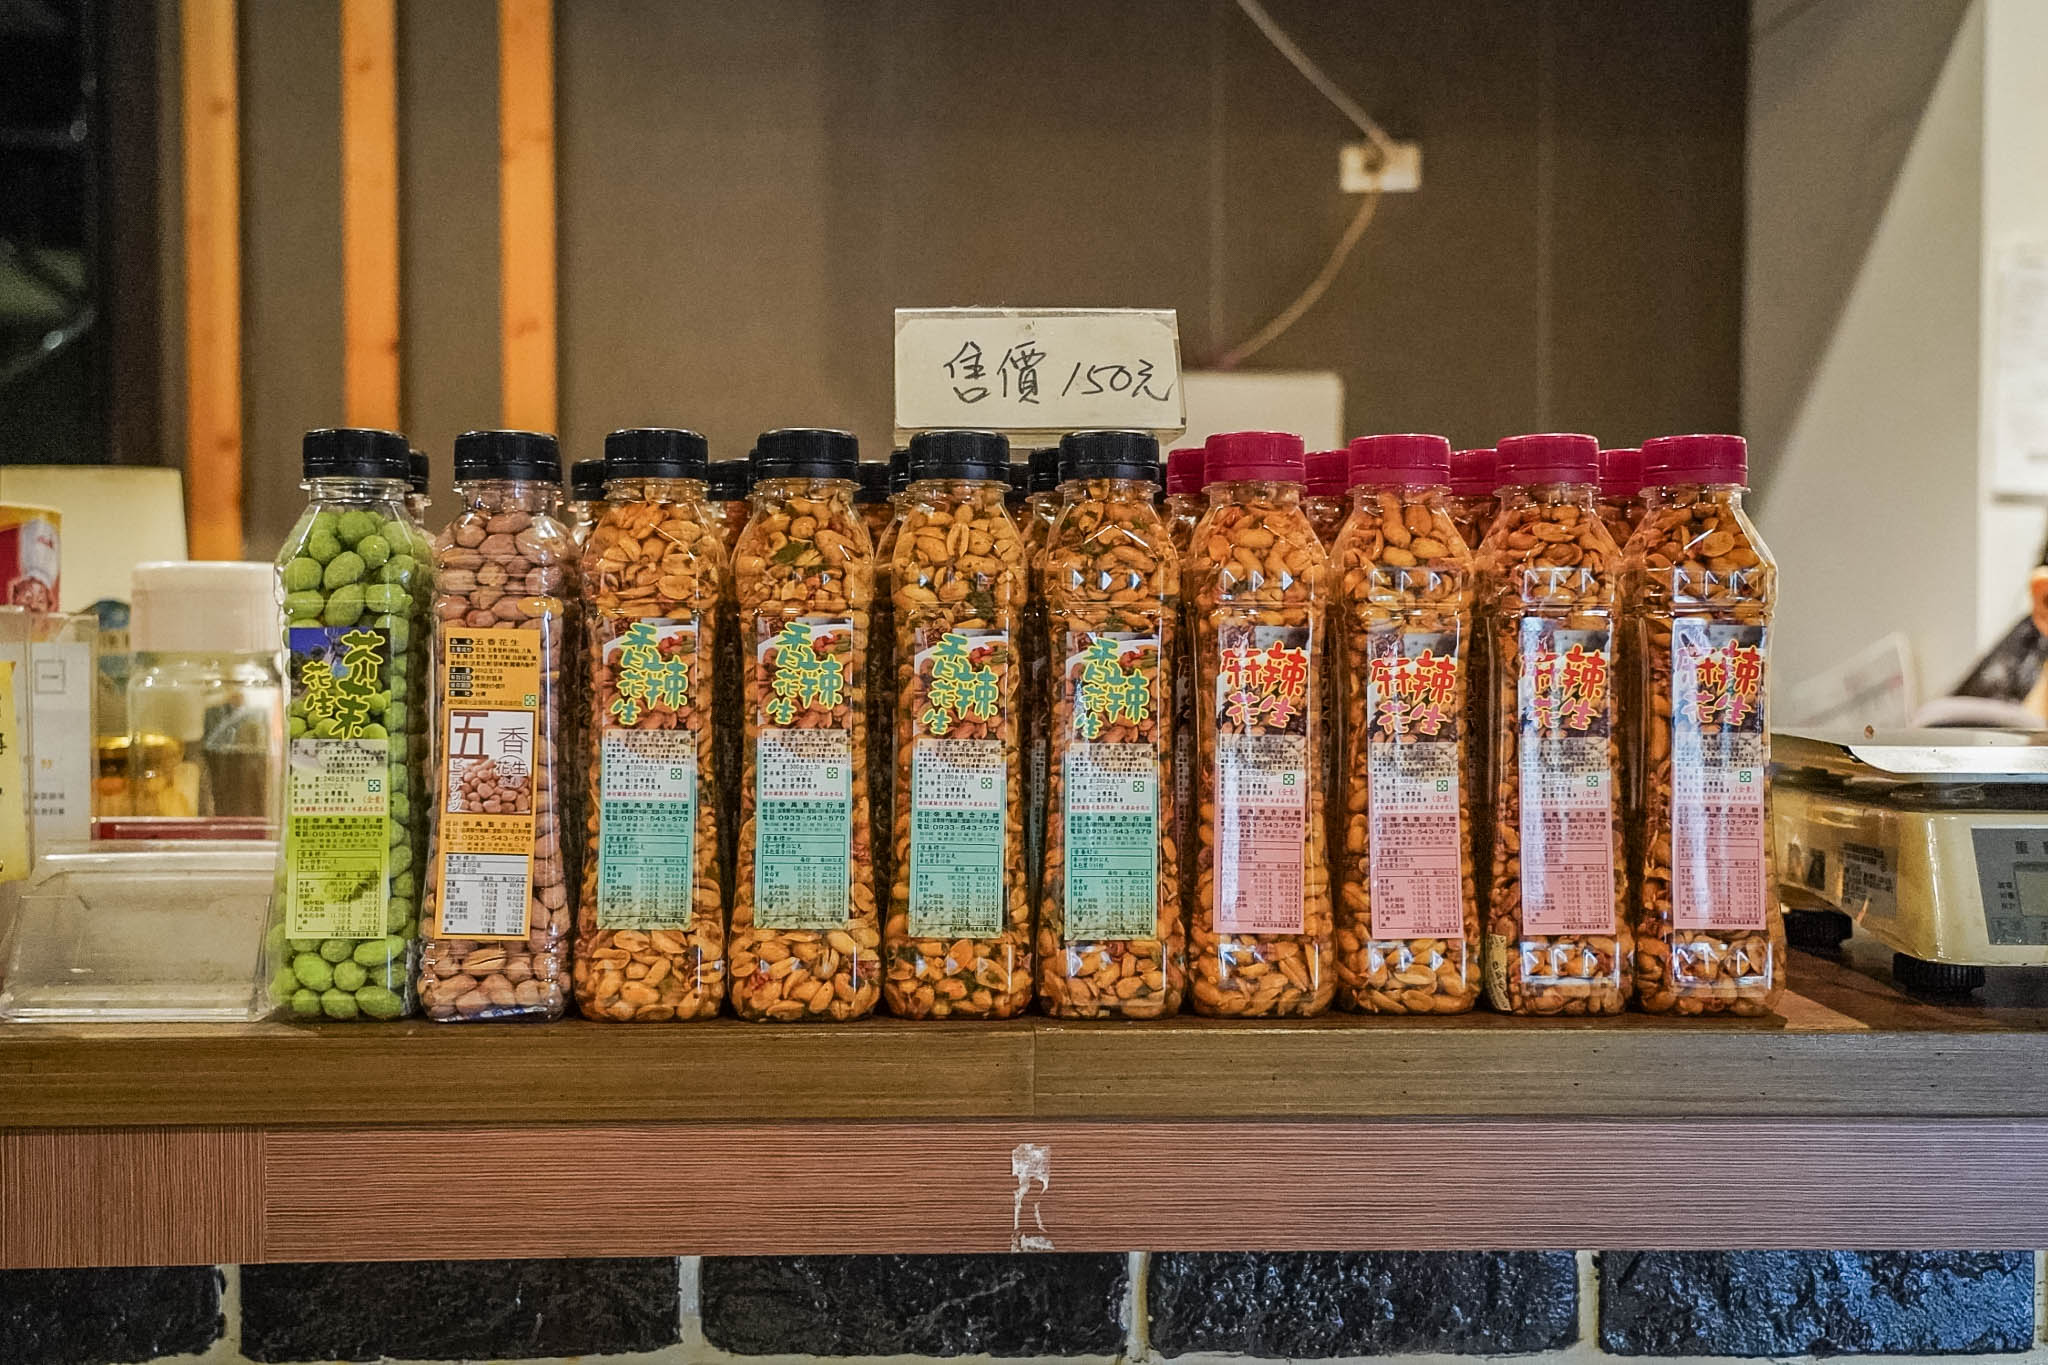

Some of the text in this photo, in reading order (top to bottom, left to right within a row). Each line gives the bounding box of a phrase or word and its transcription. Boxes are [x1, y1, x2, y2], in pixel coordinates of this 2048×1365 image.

[943, 340, 1175, 404] 售價 150元
[301, 659, 337, 718] 花生
[334, 629, 386, 740] 芥末
[1220, 640, 1308, 697] 麻辣
[1371, 648, 1456, 704] 麻辣
[1519, 643, 1607, 701] 麻辣
[1677, 639, 1761, 696] 麻辣
[1226, 690, 1297, 729] 花生
[1377, 700, 1448, 735] 花生
[1527, 695, 1598, 731] 花生
[1681, 689, 1752, 726] 花生
[495, 760, 527, 776] 花生
